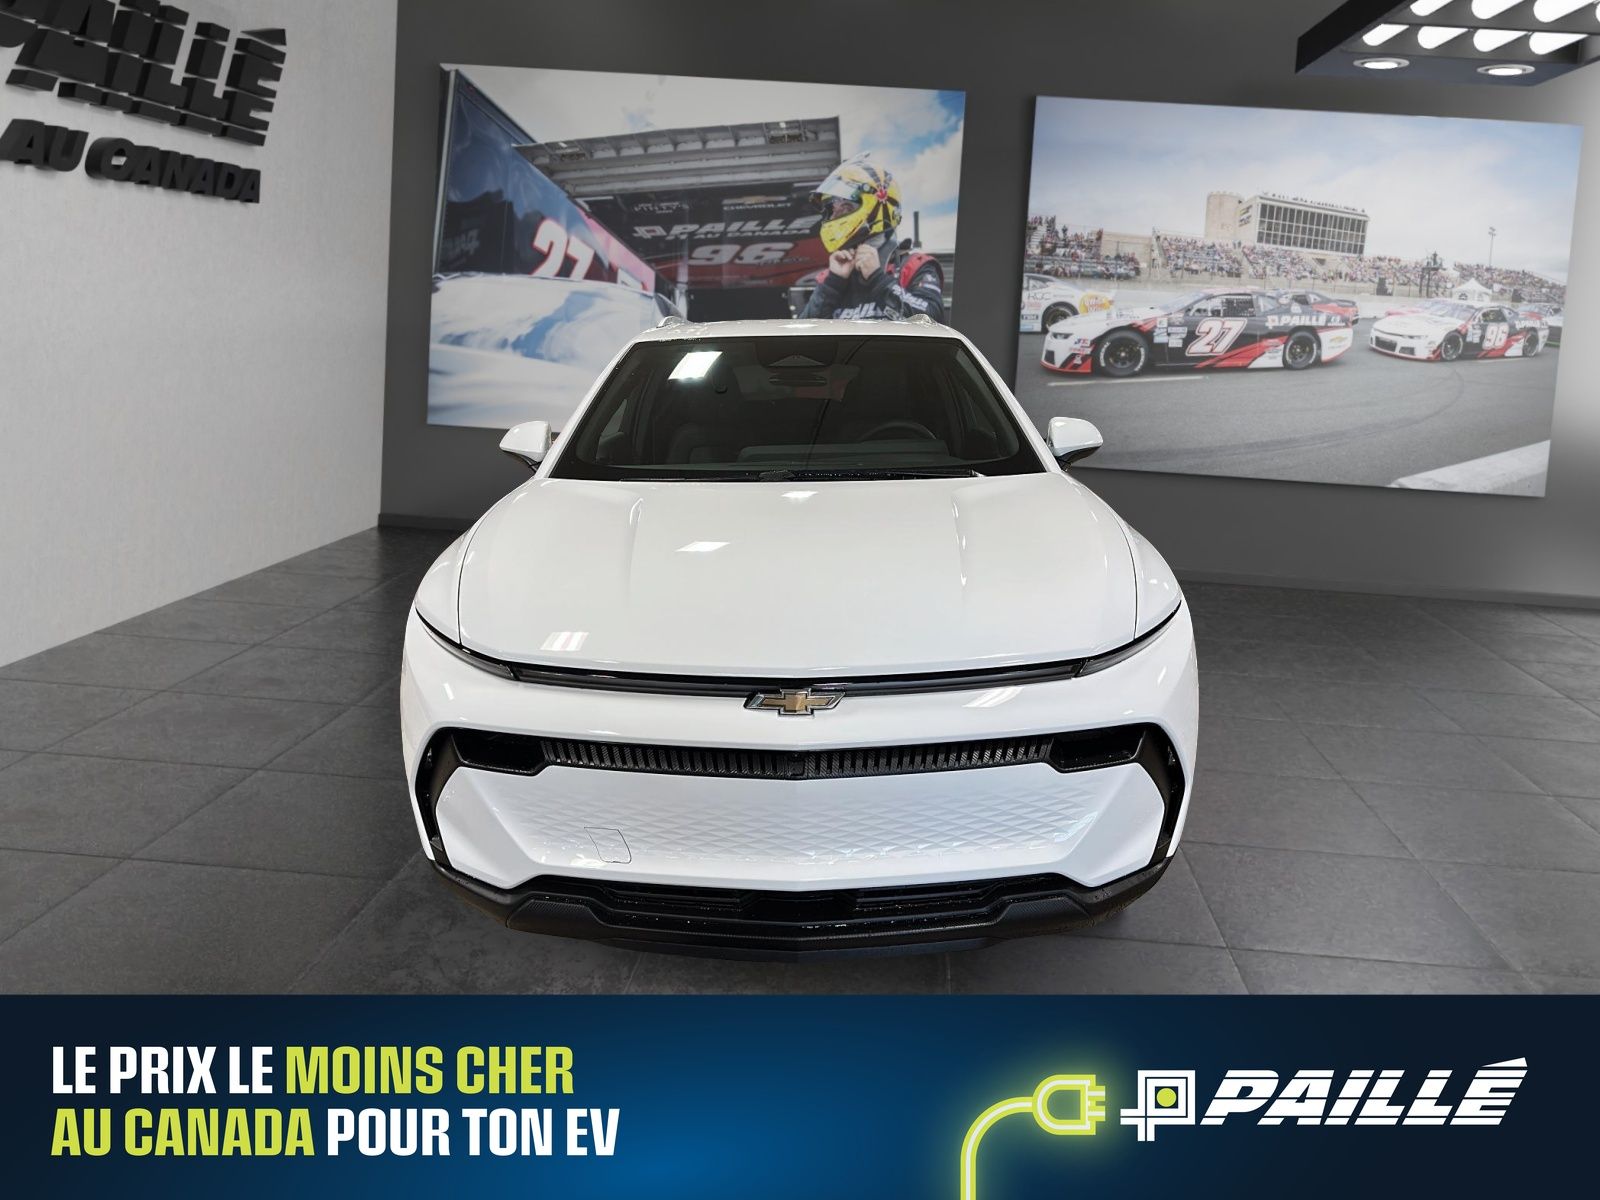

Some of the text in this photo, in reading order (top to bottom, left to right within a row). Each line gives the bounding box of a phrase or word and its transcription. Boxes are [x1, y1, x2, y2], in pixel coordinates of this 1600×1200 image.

[0, 118, 261, 203] AU CANADA
[529, 218, 595, 281] 27
[687, 242, 794, 267] 96
[1185, 317, 1248, 357] 27
[1482, 322, 1511, 351] 96
